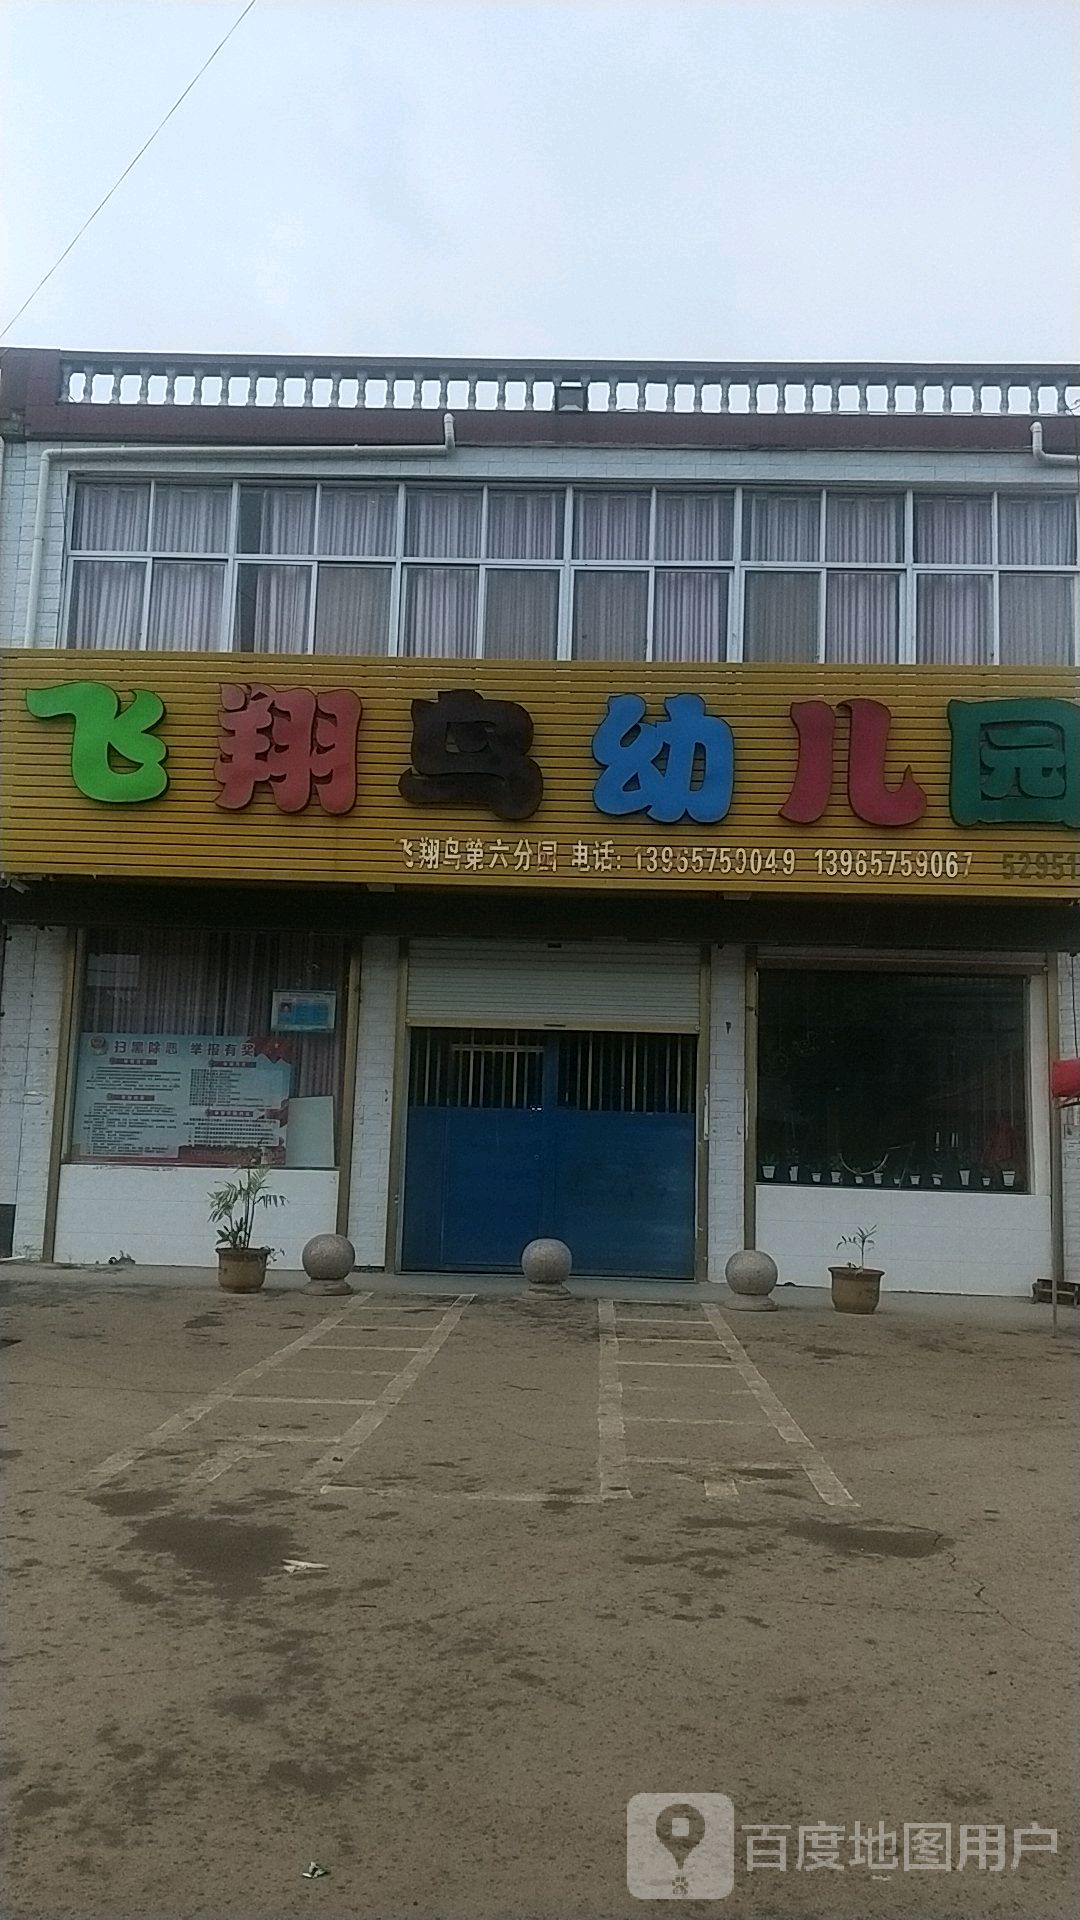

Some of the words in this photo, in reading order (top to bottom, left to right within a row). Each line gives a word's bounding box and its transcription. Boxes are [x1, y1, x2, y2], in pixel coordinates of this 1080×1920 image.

[25, 682, 1080, 829] 飞翔鸟幼儿园
[399, 836, 558, 872] 飞翔鸟第六分园
[634, 846, 796, 875] 13965759049
[814, 848, 973, 878] 13965759067
[113, 1040, 178, 1055] 扫黑除恶
[190, 1042, 255, 1057] 举报有奖
